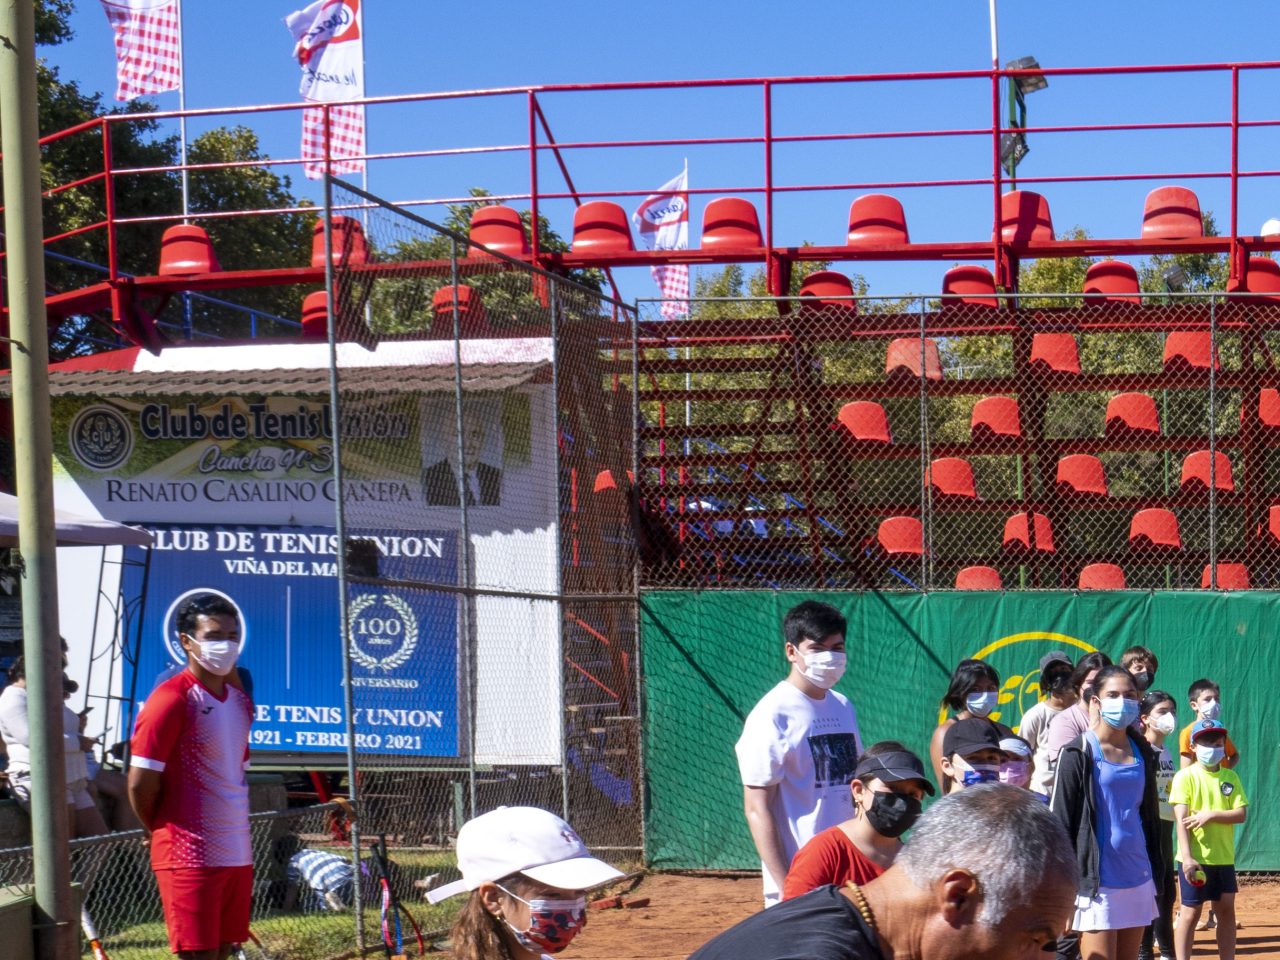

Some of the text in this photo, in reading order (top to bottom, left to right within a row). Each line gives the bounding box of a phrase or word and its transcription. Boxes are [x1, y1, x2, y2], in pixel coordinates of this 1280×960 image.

[140, 403, 207, 439] Club
[210, 403, 248, 439] de
[249, 404, 319, 439] Tenis
[199, 444, 276, 472] Cancha
[106, 480, 197, 502] RENATO
[203, 480, 316, 502] CASALINO
[216, 531, 255, 552] DE
[261, 533, 338, 554] TENIS
[224, 557, 338, 577] VIÑA DEL MA
[356, 617, 401, 636] 100
[275, 705, 342, 724] TENIS
[366, 708, 444, 728] UNION
[248, 729, 281, 745] 1921
[385, 734, 421, 749] 2021
